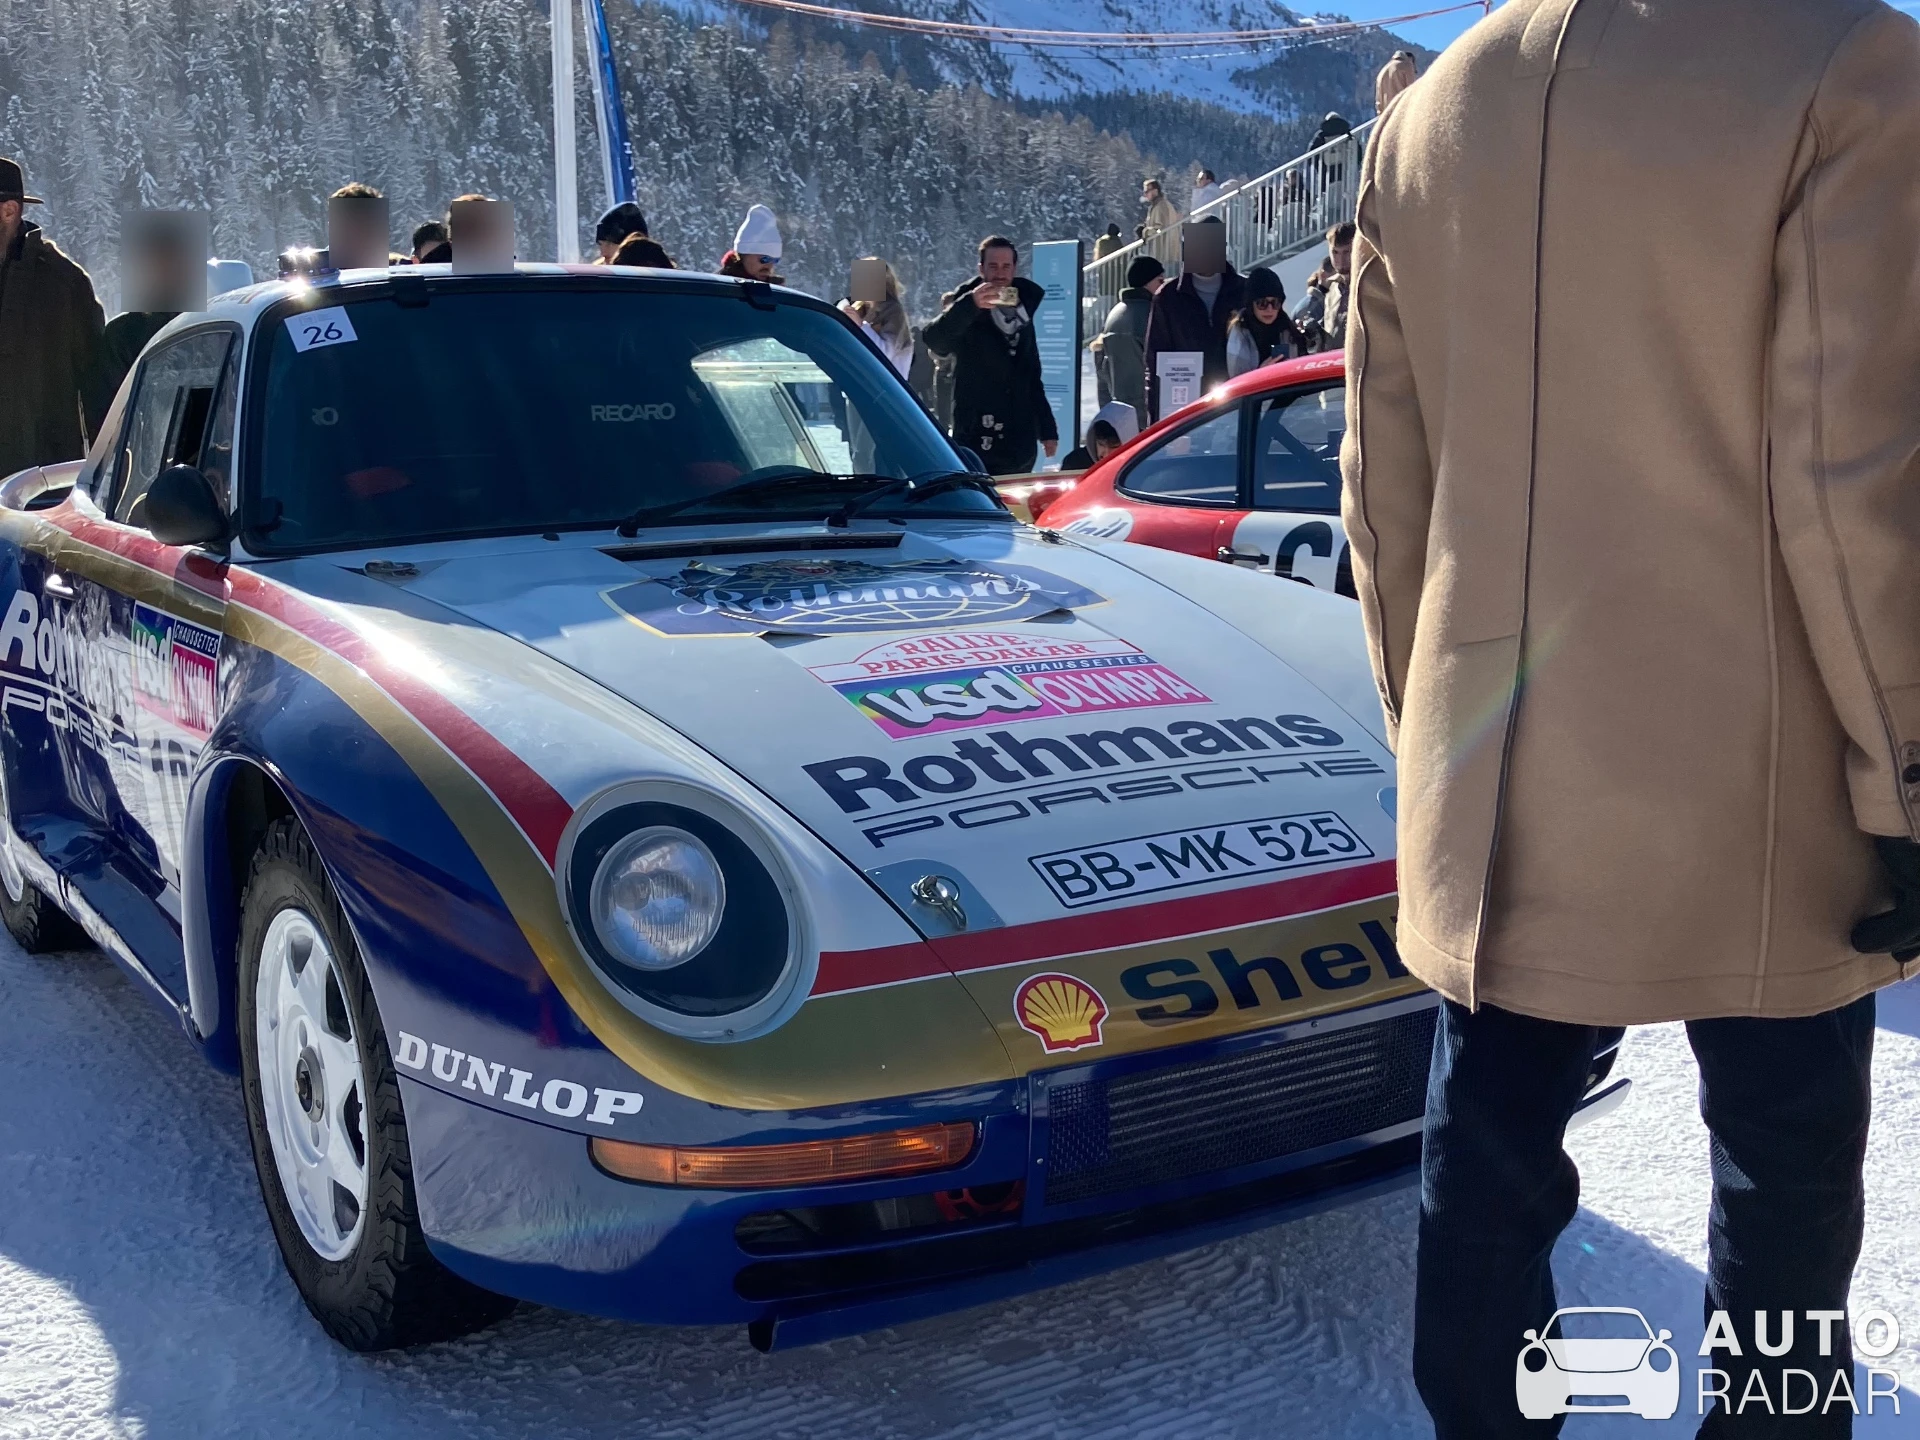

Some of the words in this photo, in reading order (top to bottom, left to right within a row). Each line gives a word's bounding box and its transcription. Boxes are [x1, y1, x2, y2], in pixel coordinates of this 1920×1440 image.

[303, 321, 343, 346] 26
[590, 402, 676, 422] RECARO
[671, 573, 1070, 616] Rothmans
[173, 624, 219, 655] CHAUSSETTES
[860, 643, 1095, 674] PARIS-DAKAR
[894, 633, 1029, 657] RALLYE
[1012, 655, 1150, 674] CHAUSSETTES
[1025, 668, 1205, 709] OLYMPIA
[801, 713, 1345, 814] Rothmans
[860, 757, 1386, 849] PORSCHE
[1042, 829, 1242, 898] BB-MK
[1254, 817, 1358, 863] 525
[1119, 915, 1411, 1028] Shel
[394, 1030, 645, 1126] DUNLOP
